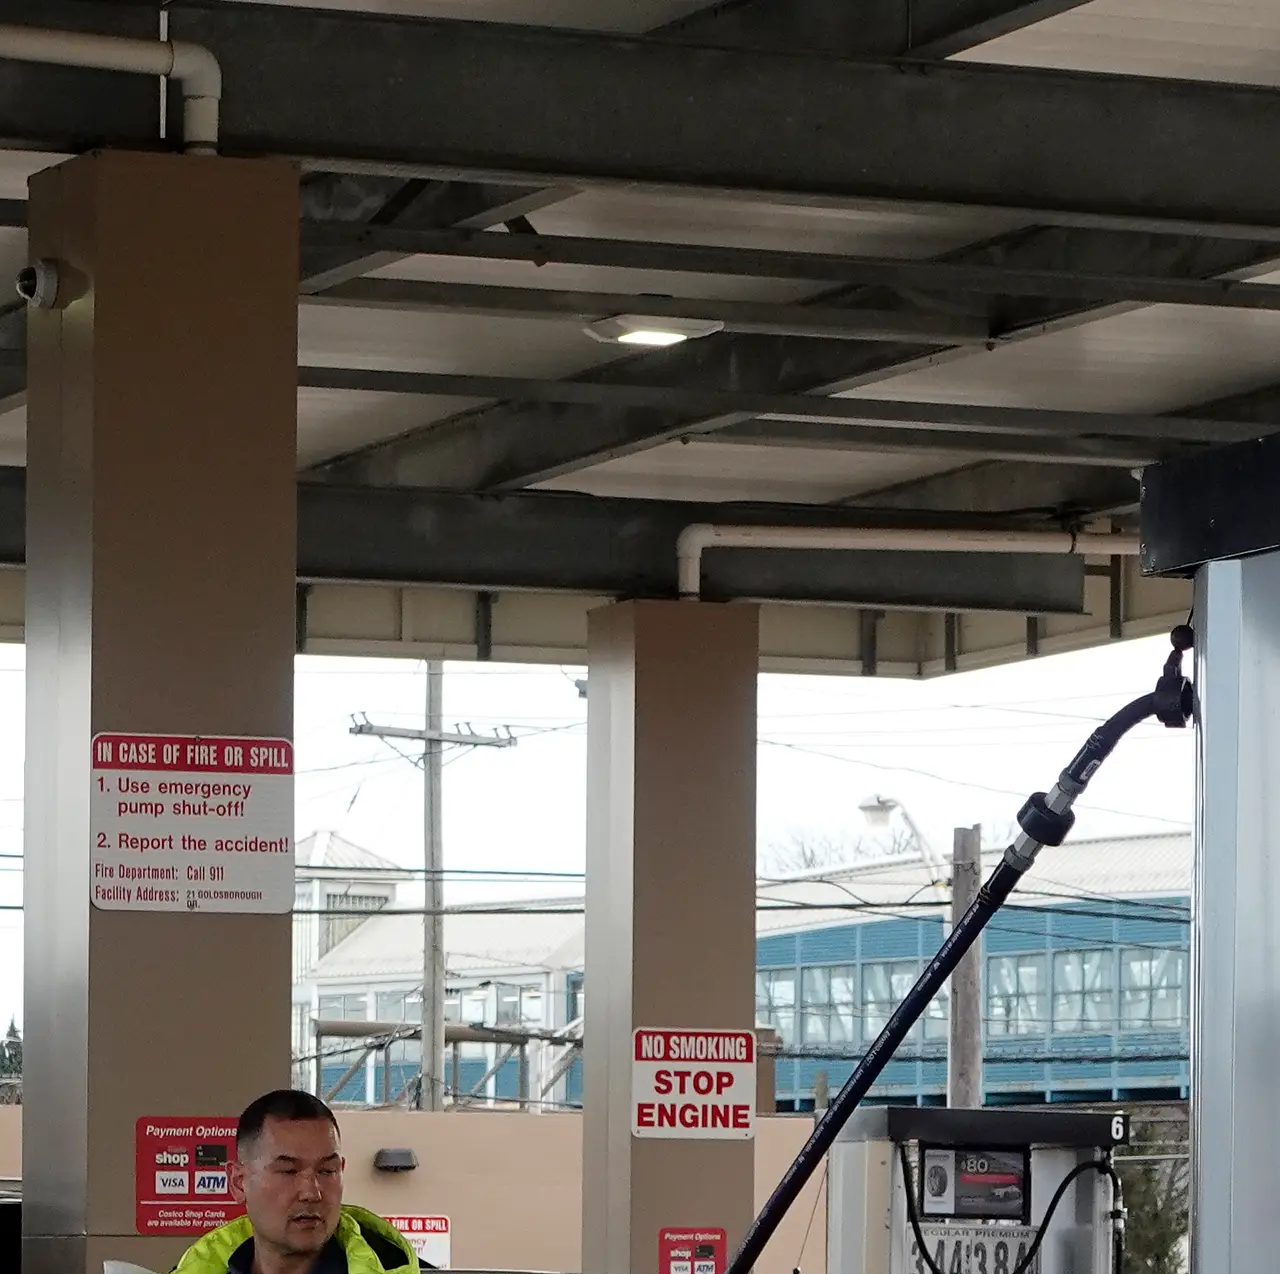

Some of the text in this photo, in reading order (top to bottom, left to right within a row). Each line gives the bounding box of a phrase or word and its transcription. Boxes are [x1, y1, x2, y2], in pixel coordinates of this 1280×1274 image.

[97, 742, 288, 768] IN CASE OF FIRE OR SPILL
[97, 776, 252, 799] 1. Use emergency
[118, 800, 245, 818] pump shut-off!
[97, 832, 289, 853] 2. Report the accident!
[95, 863, 224, 881] Fire Department: Call 911
[95, 885, 262, 902] Facility Address: 21 GOLDSBOROUGH
[641, 1035, 747, 1061] NO SMOKING
[654, 1069, 734, 1095] STOP
[637, 1103, 750, 1129] ENGINE
[146, 1125, 238, 1139] Payment Options
[1111, 1117, 1124, 1140] 6
[155, 1151, 189, 1167] shop
[160, 1176, 226, 1189] VISA ATM
[158, 1210, 225, 1219] Costco Shop Cards
[160, 1219, 191, 1227] available
[192, 1219, 202, 1227] for
[392, 1219, 447, 1231] FIRE OR SPILL
[665, 1232, 721, 1242] Payment Options
[670, 1248, 691, 1260] shop
[696, 1264, 715, 1273] ATM
